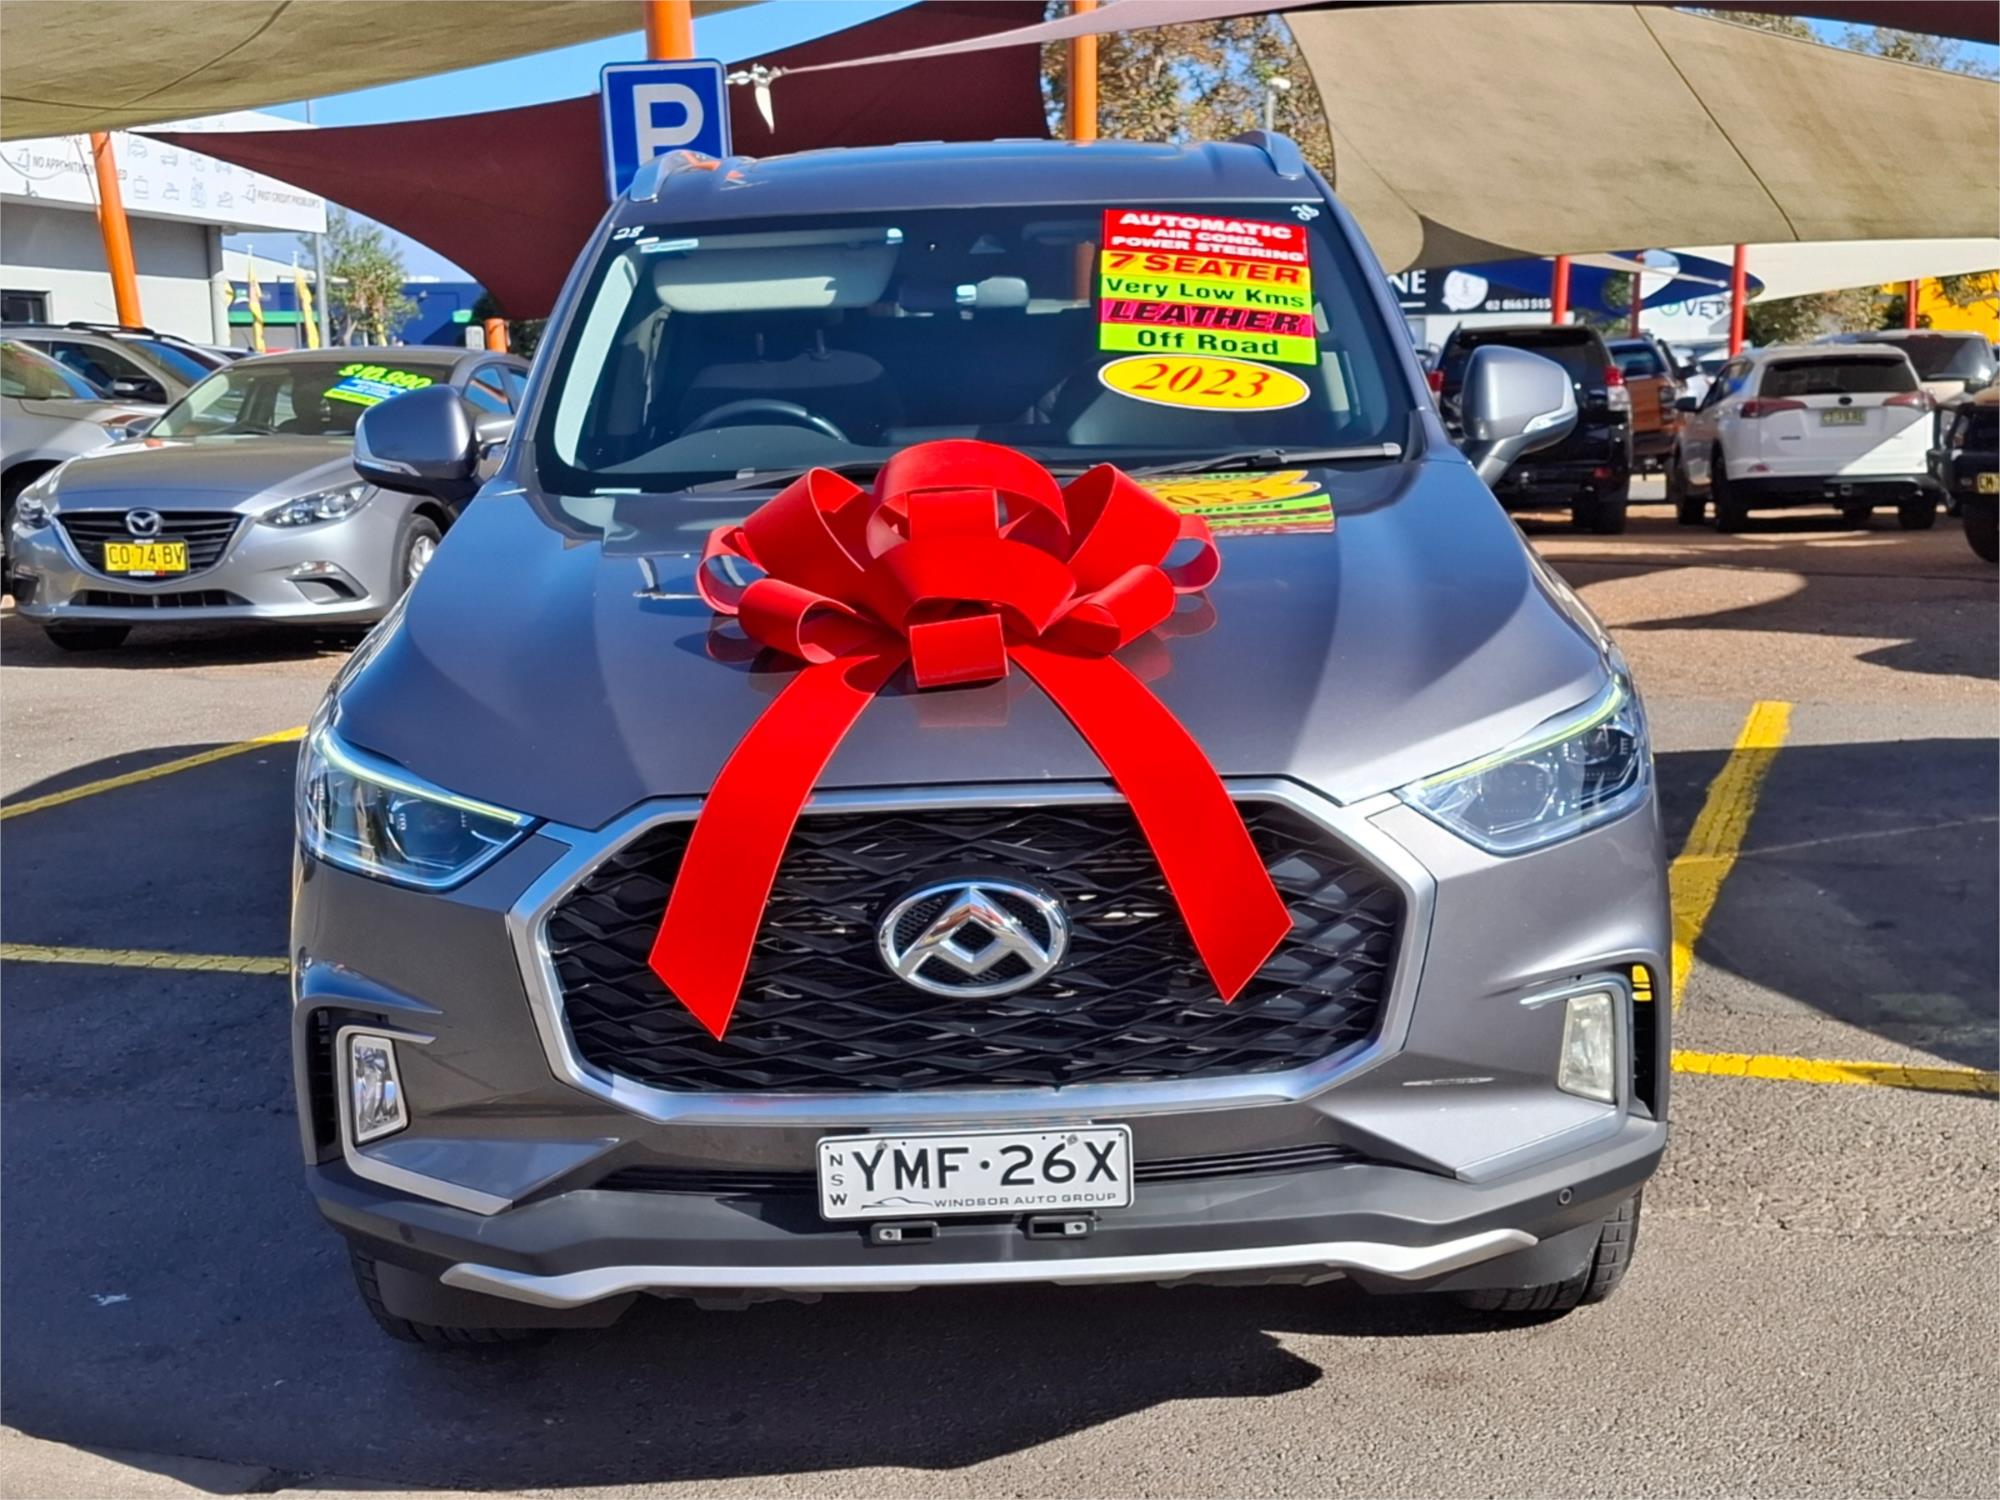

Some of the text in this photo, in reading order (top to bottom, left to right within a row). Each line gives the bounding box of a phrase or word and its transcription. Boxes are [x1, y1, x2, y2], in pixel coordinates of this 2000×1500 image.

[632, 83, 704, 167] P
[1119, 212, 1292, 240] AUTOMATIC
[1153, 228, 1264, 247] AIR COND.
[1111, 236, 1305, 262] POWER STEERING
[1109, 253, 1301, 284] 7 SEATER
[1106, 278, 1305, 308] Very Low Kms
[1109, 301, 1303, 332] LEATHER
[1137, 329, 1279, 355] Off Road
[1131, 363, 1271, 399] 2023
[933, 1192, 1117, 1208] WINDSOR AUTO GROUP
